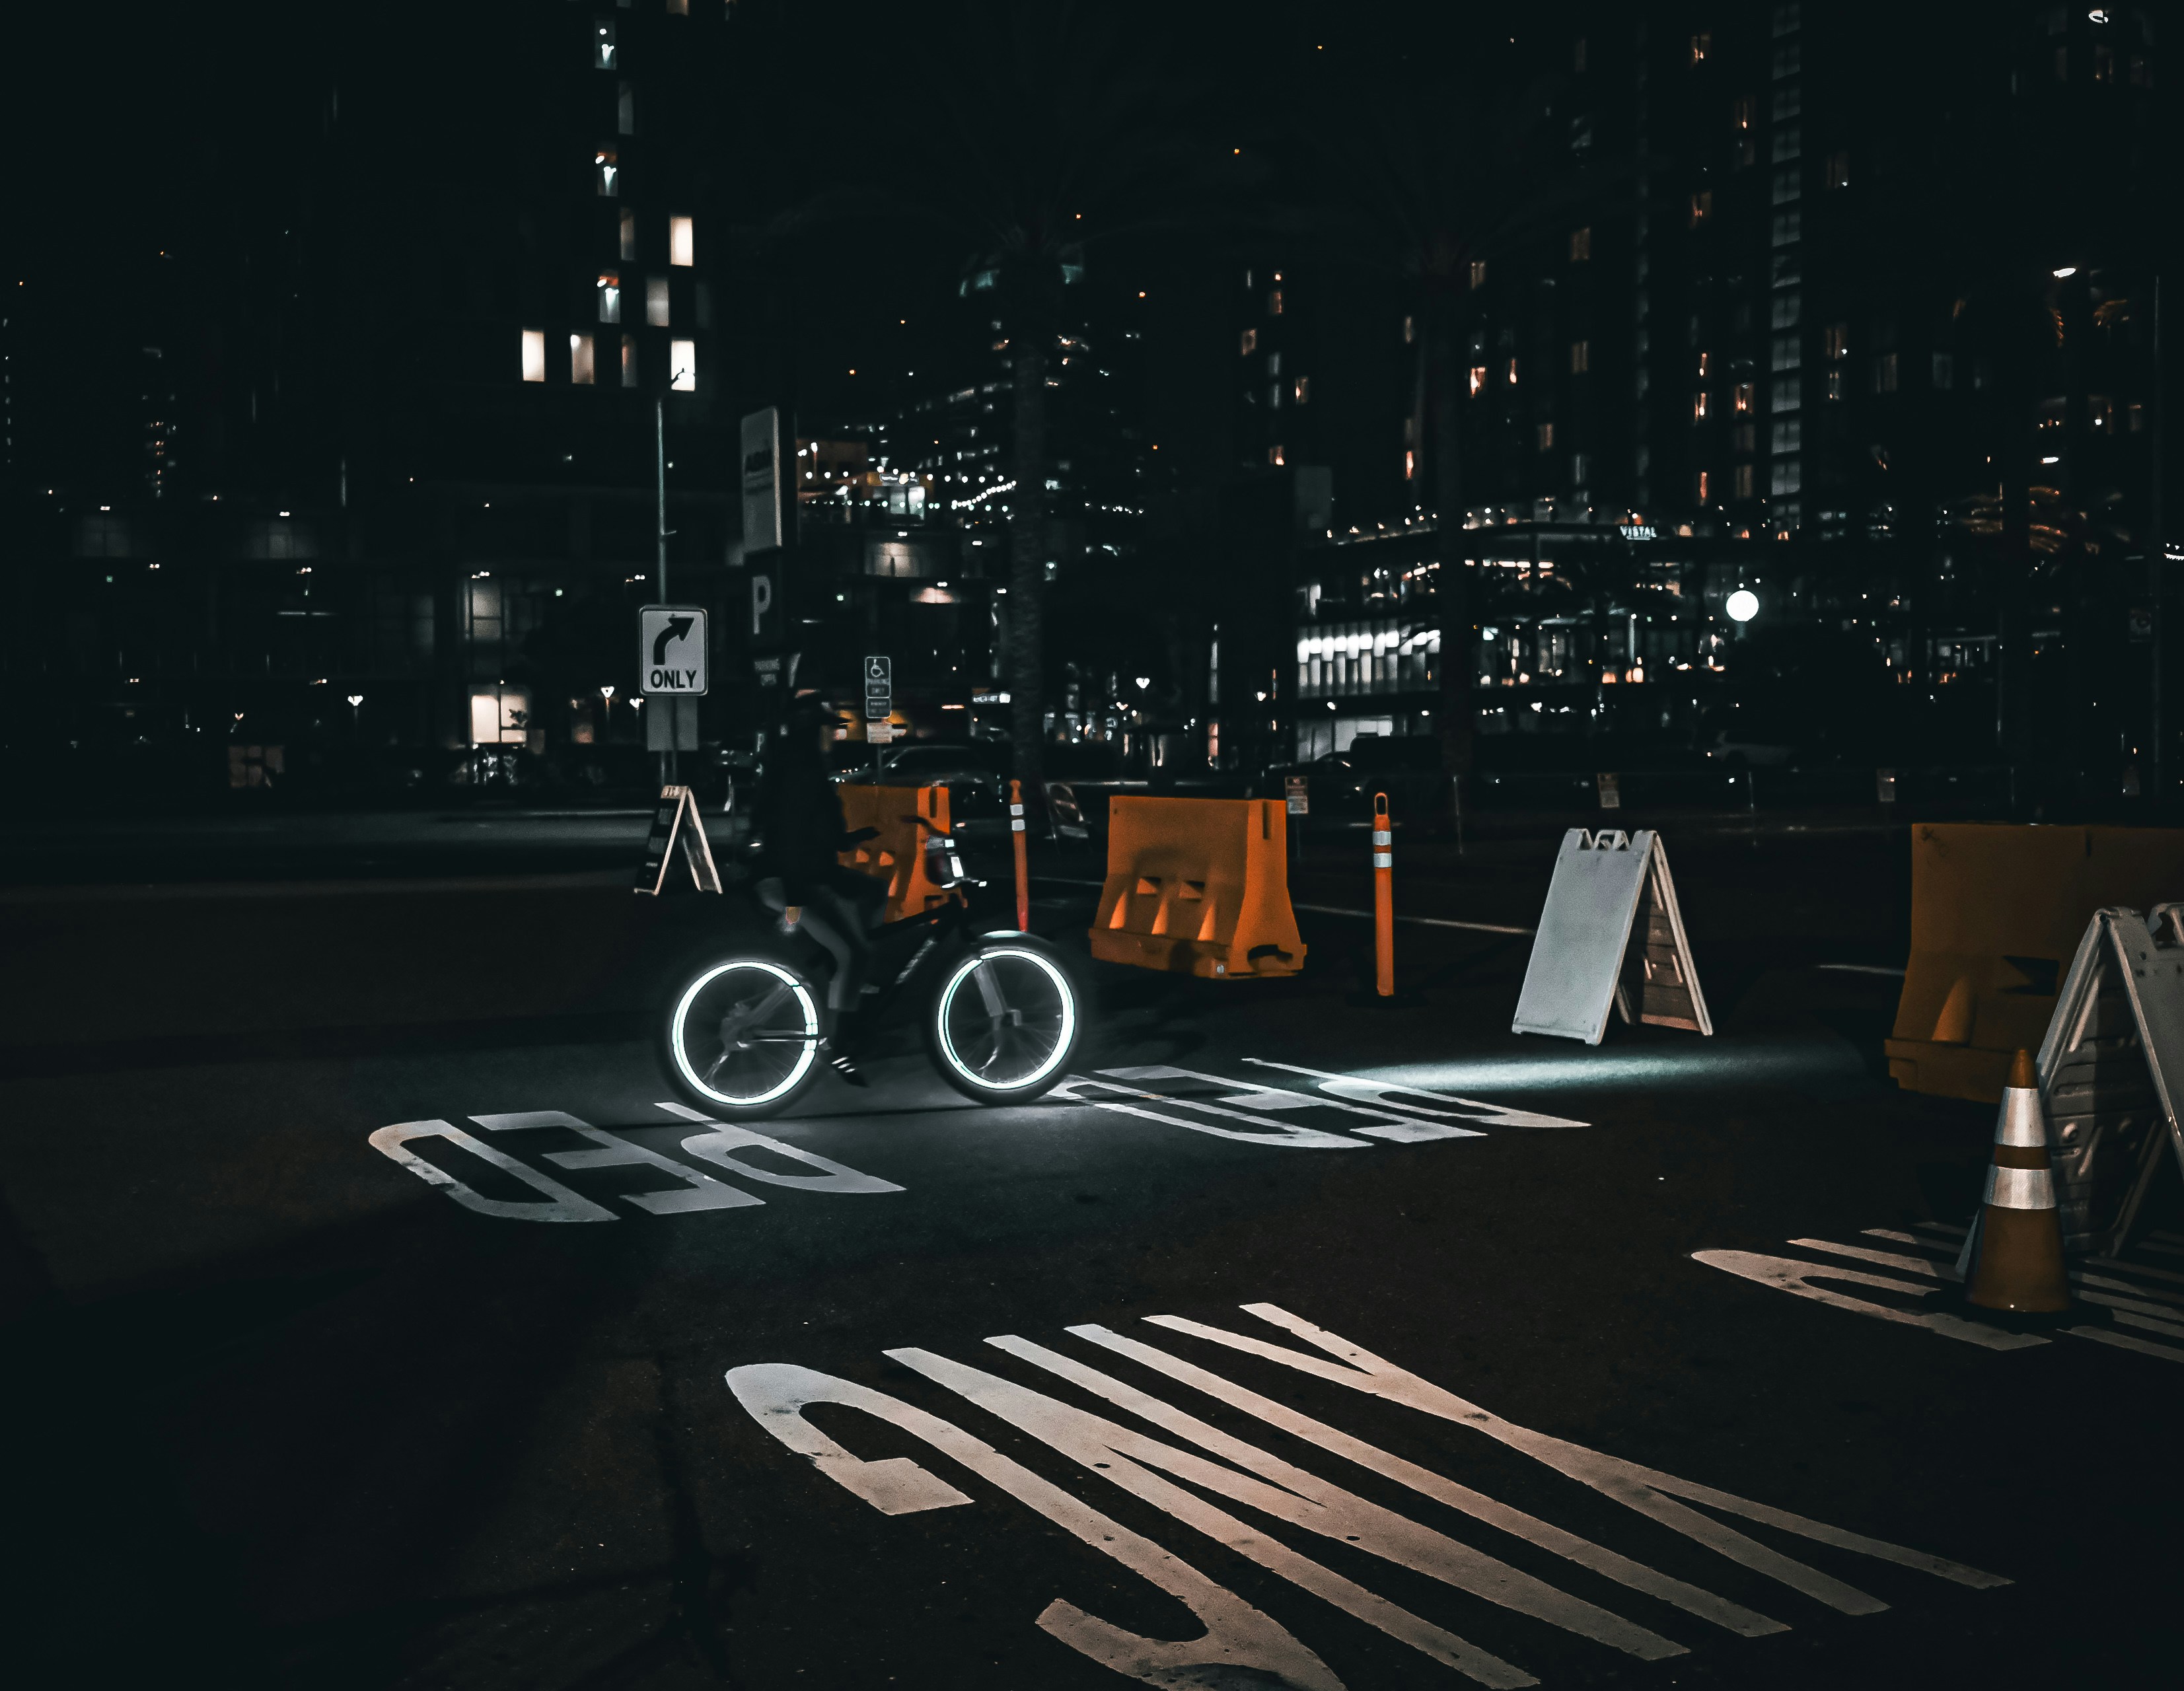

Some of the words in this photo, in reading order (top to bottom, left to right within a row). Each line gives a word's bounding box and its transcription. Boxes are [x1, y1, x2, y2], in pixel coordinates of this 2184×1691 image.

[1620, 526, 1657, 538] VISTAL
[752, 575, 772, 635] P
[650, 669, 697, 689] ONLY
[367, 1102, 908, 1222] PED
